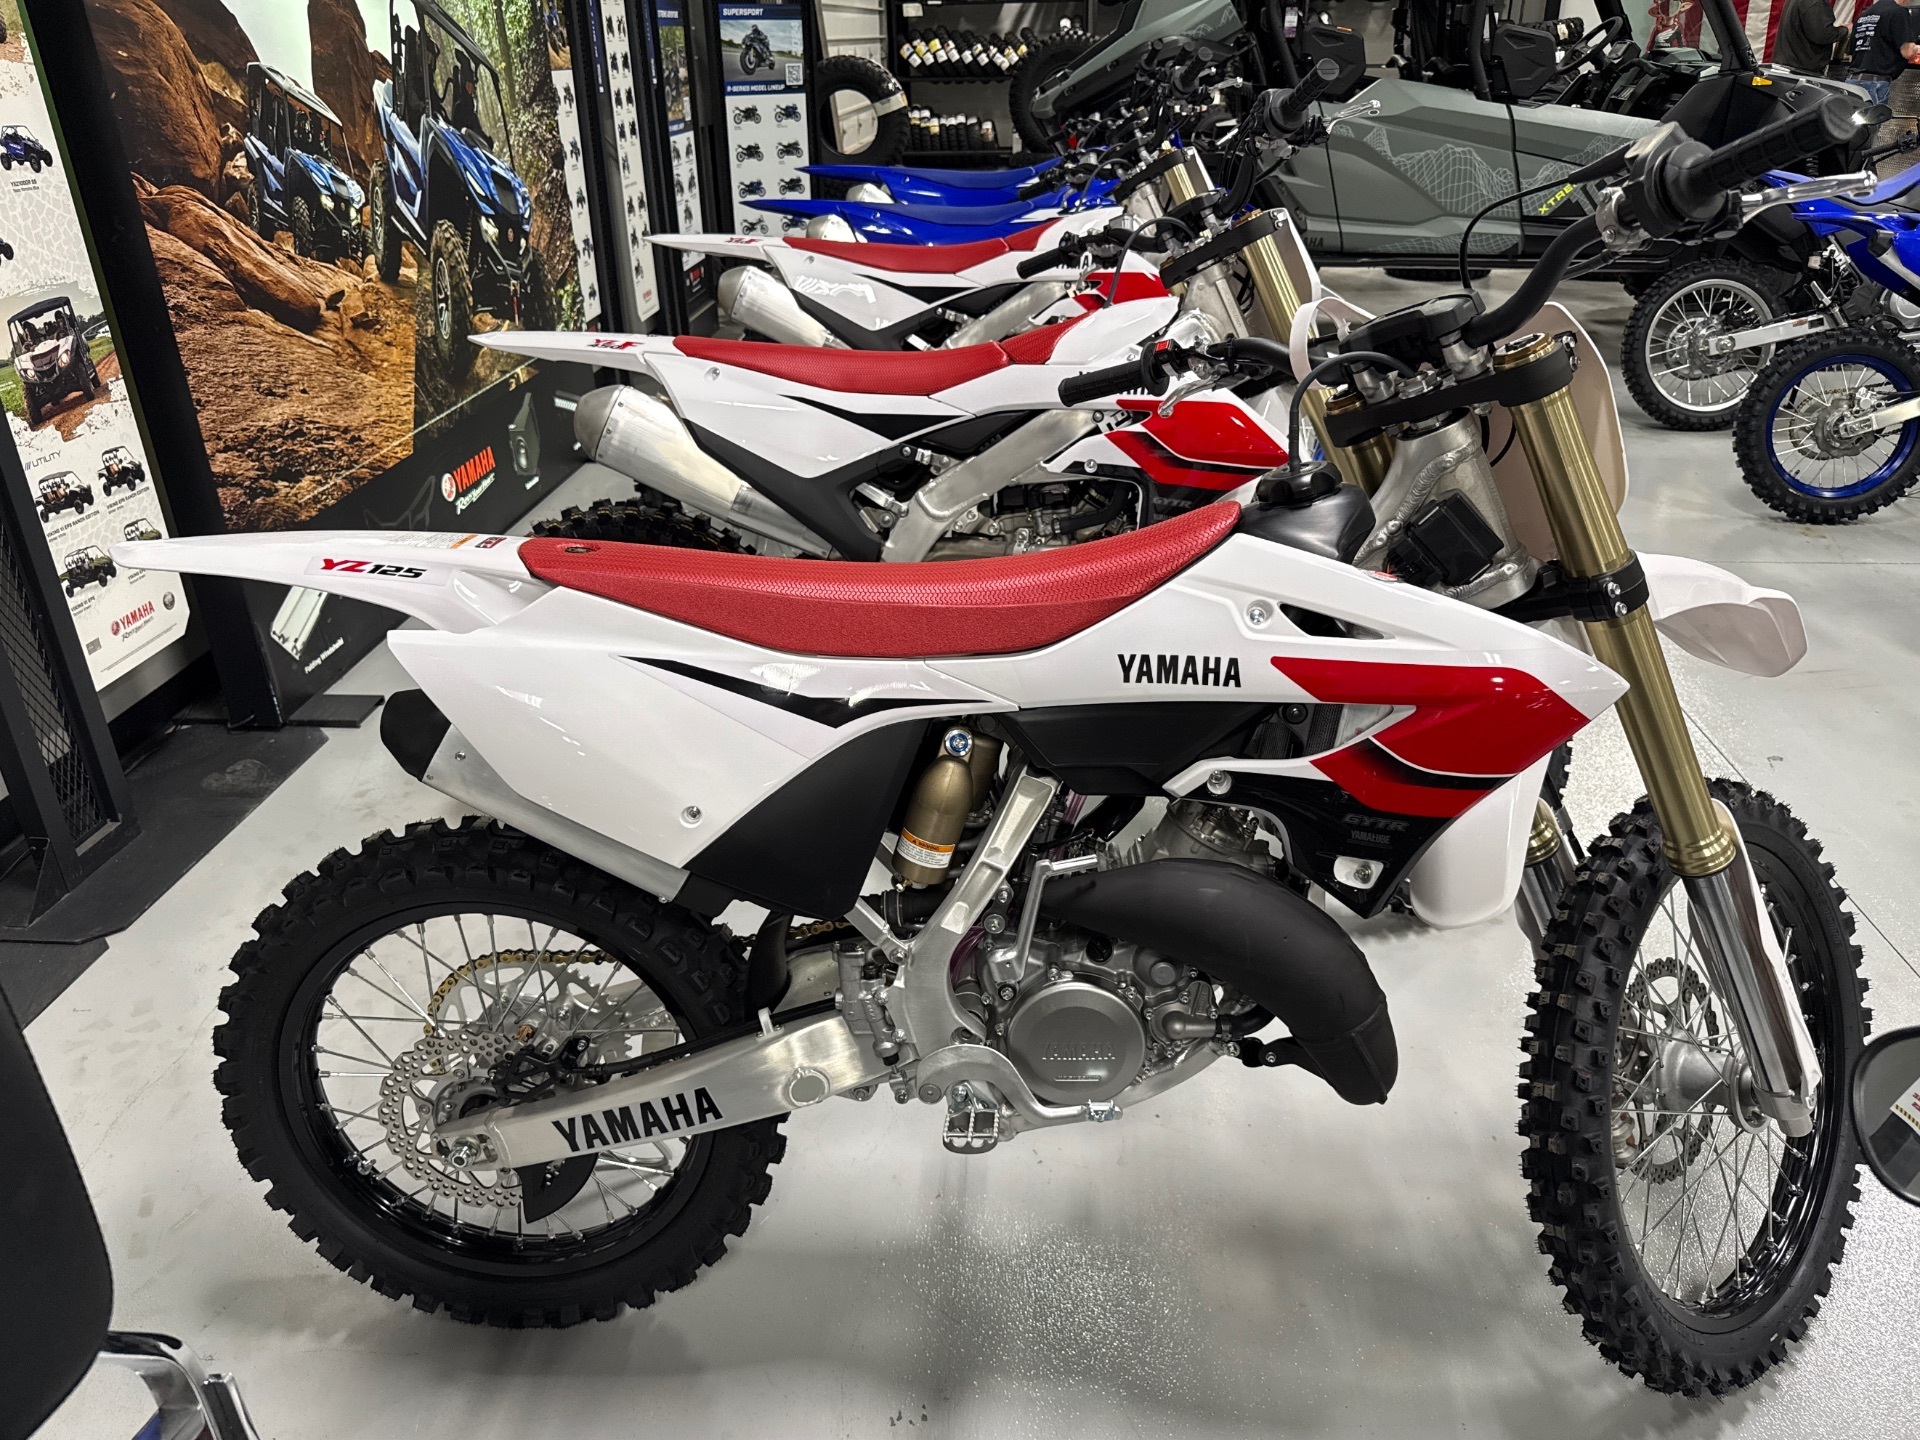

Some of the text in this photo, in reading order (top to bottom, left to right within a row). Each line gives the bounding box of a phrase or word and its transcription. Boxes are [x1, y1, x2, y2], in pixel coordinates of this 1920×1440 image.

[722, 8, 764, 16] SUPERSPORT
[768, 83, 785, 91] LINEUP
[1538, 182, 1578, 215] XTRE
[31, 450, 62, 468] UTILITY
[453, 445, 496, 493] YAMAHA
[320, 557, 428, 580] YZ125
[119, 600, 155, 630] YAMAHA
[1117, 653, 1242, 688] YAMAHA
[1341, 813, 1410, 832] GYTR
[1351, 829, 1392, 845] YAMALUBE
[1041, 1042, 1116, 1061] YAMAHA
[551, 1086, 724, 1153] YAMAHA
